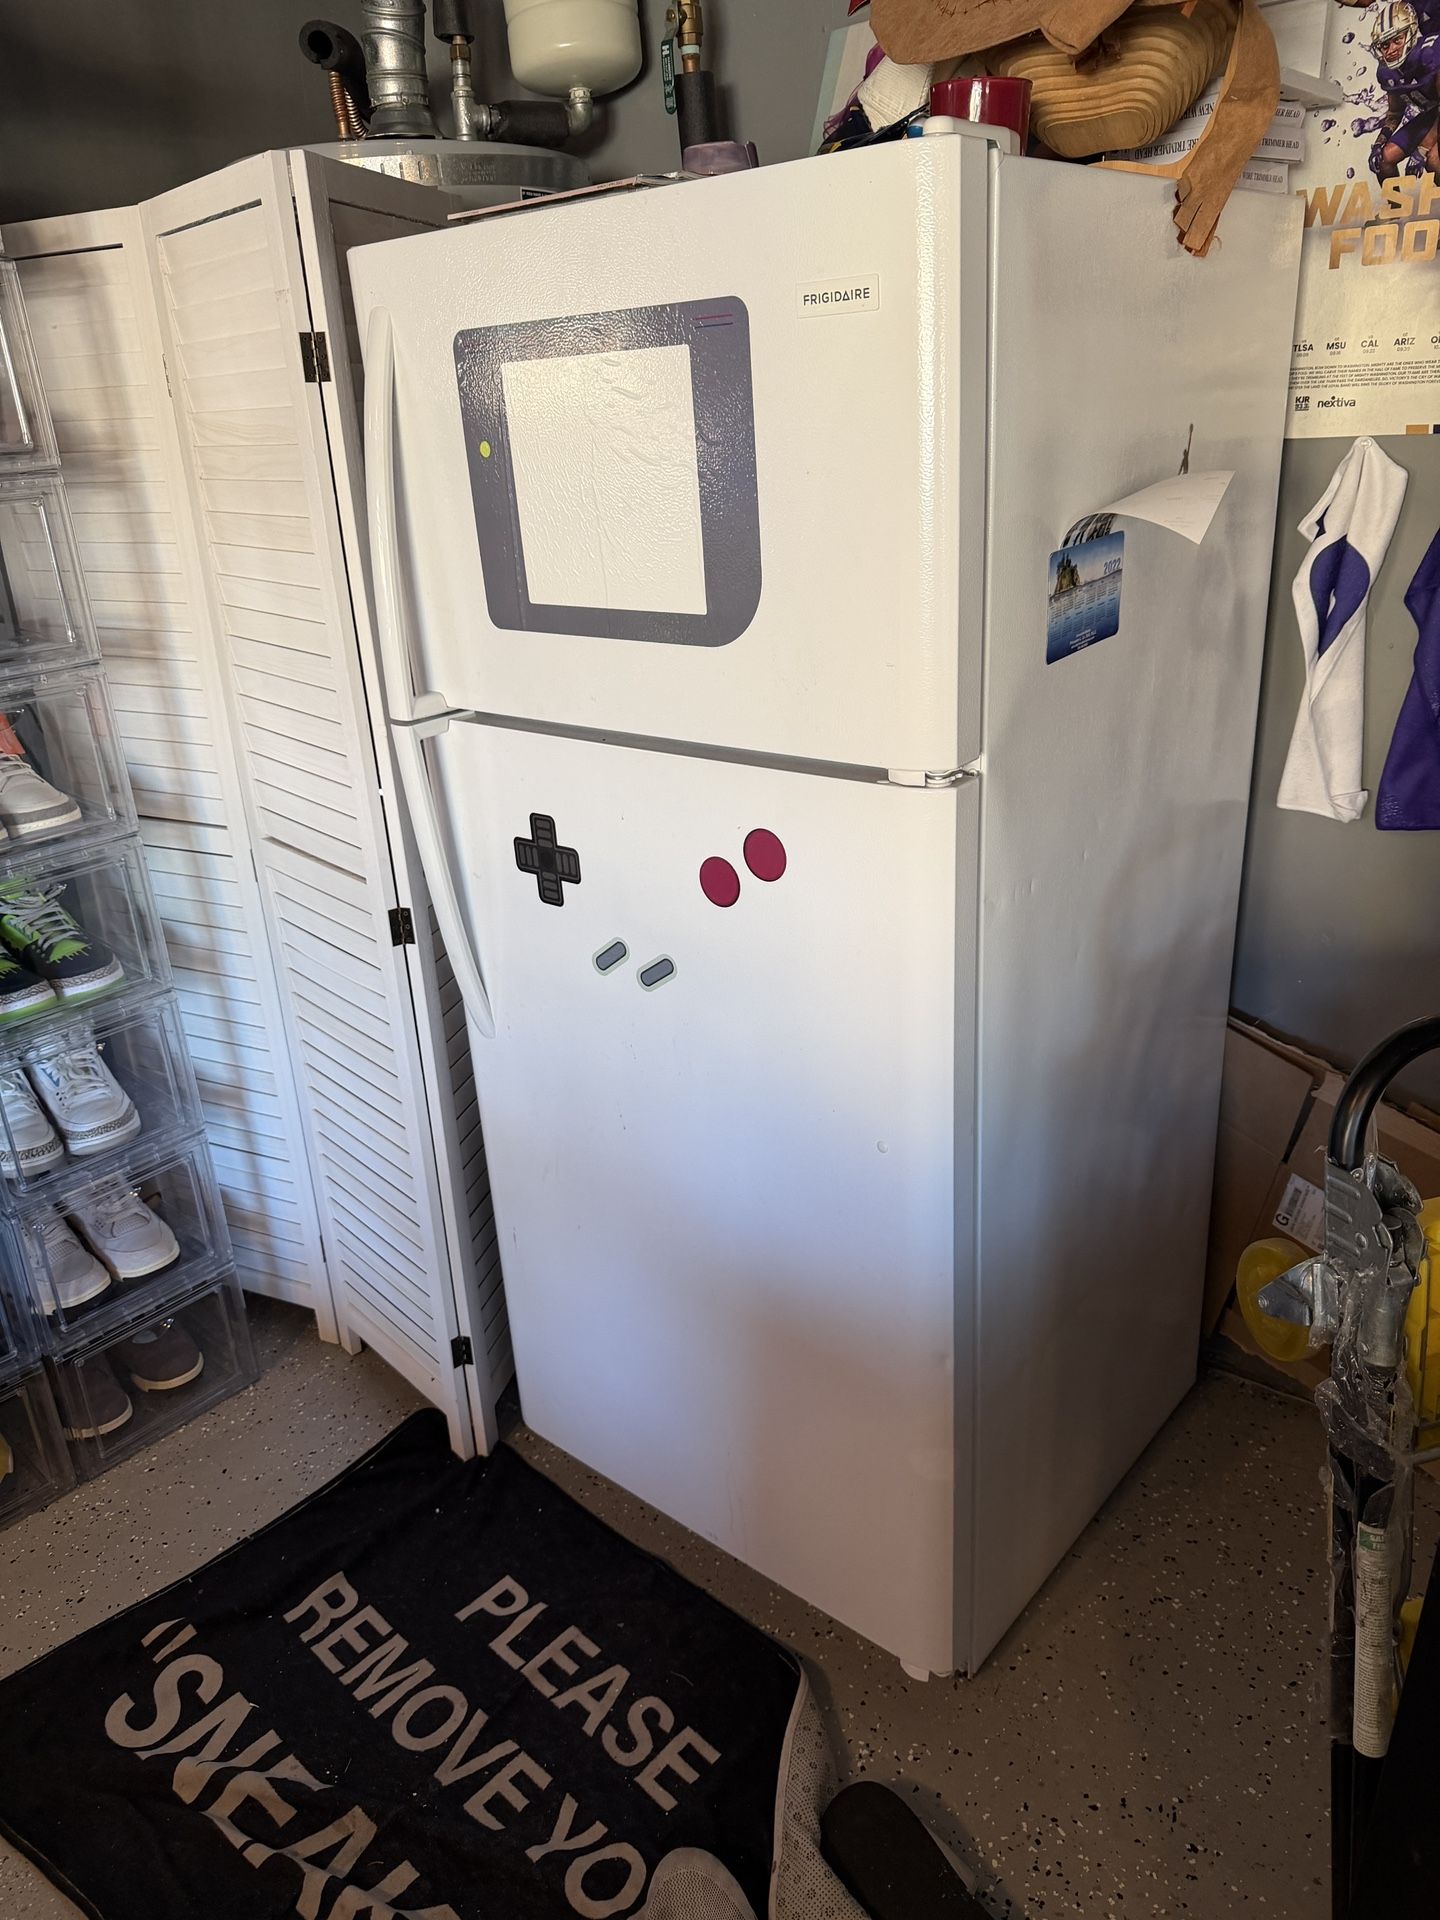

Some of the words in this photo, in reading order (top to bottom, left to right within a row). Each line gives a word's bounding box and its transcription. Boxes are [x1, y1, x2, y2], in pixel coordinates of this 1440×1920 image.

[1284, 108, 1301, 119] HEAD
[1154, 140, 1186, 156] TRIMMER
[1261, 138, 1286, 148] TRIMMER
[1286, 140, 1300, 149] HEAD
[1134, 146, 1153, 160] HEAD
[803, 287, 870, 306] FRIGIDAIRE
[1293, 343, 1314, 352] TLSA
[1326, 341, 1346, 351] MSU
[1360, 339, 1379, 348] CAL
[1393, 337, 1416, 346] ARIZ
[1317, 395, 1356, 408] nextiva
[1103, 557, 1121, 575] 2022
[455, 1575, 721, 1811] PLEASE
[283, 1571, 553, 1831] REMOVE
[525, 1794, 648, 1917] YO
